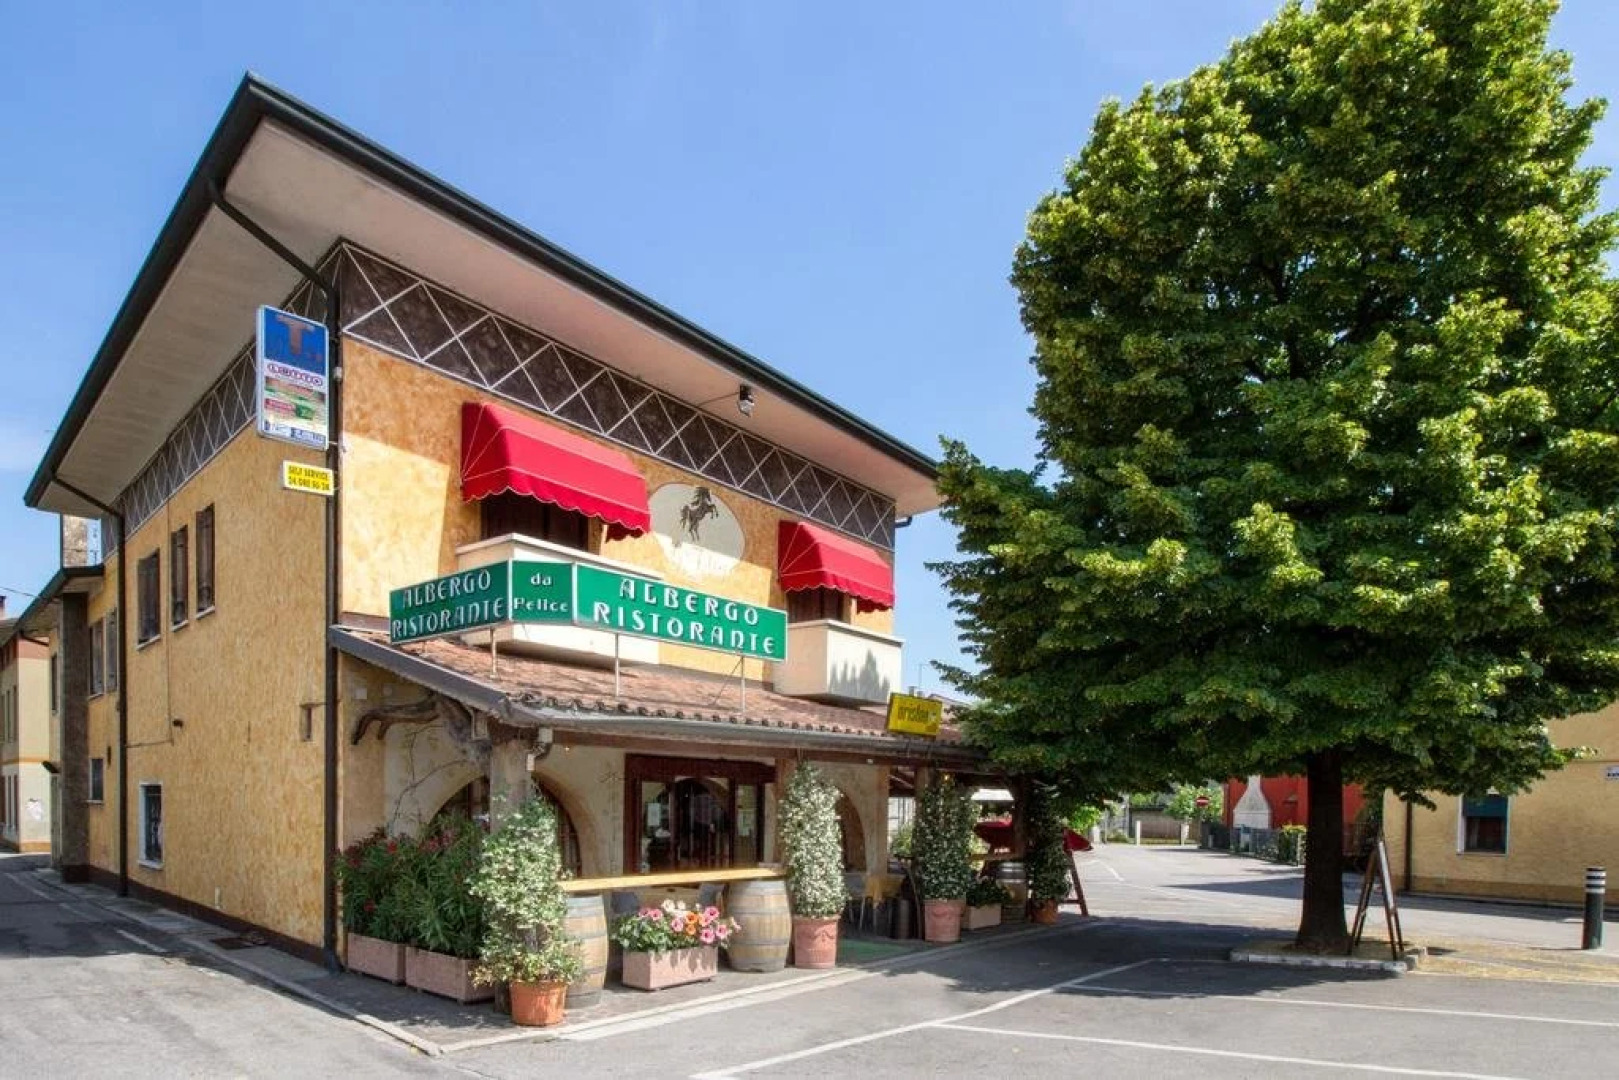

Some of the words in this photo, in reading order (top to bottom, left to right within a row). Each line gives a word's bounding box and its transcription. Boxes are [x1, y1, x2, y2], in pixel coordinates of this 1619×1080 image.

[403, 568, 491, 609] ALBERGO
[530, 573, 552, 586] da
[391, 597, 504, 639] RISTORANTE
[619, 578, 758, 626] ALBERGO
[593, 601, 775, 654] RISTORANTE
